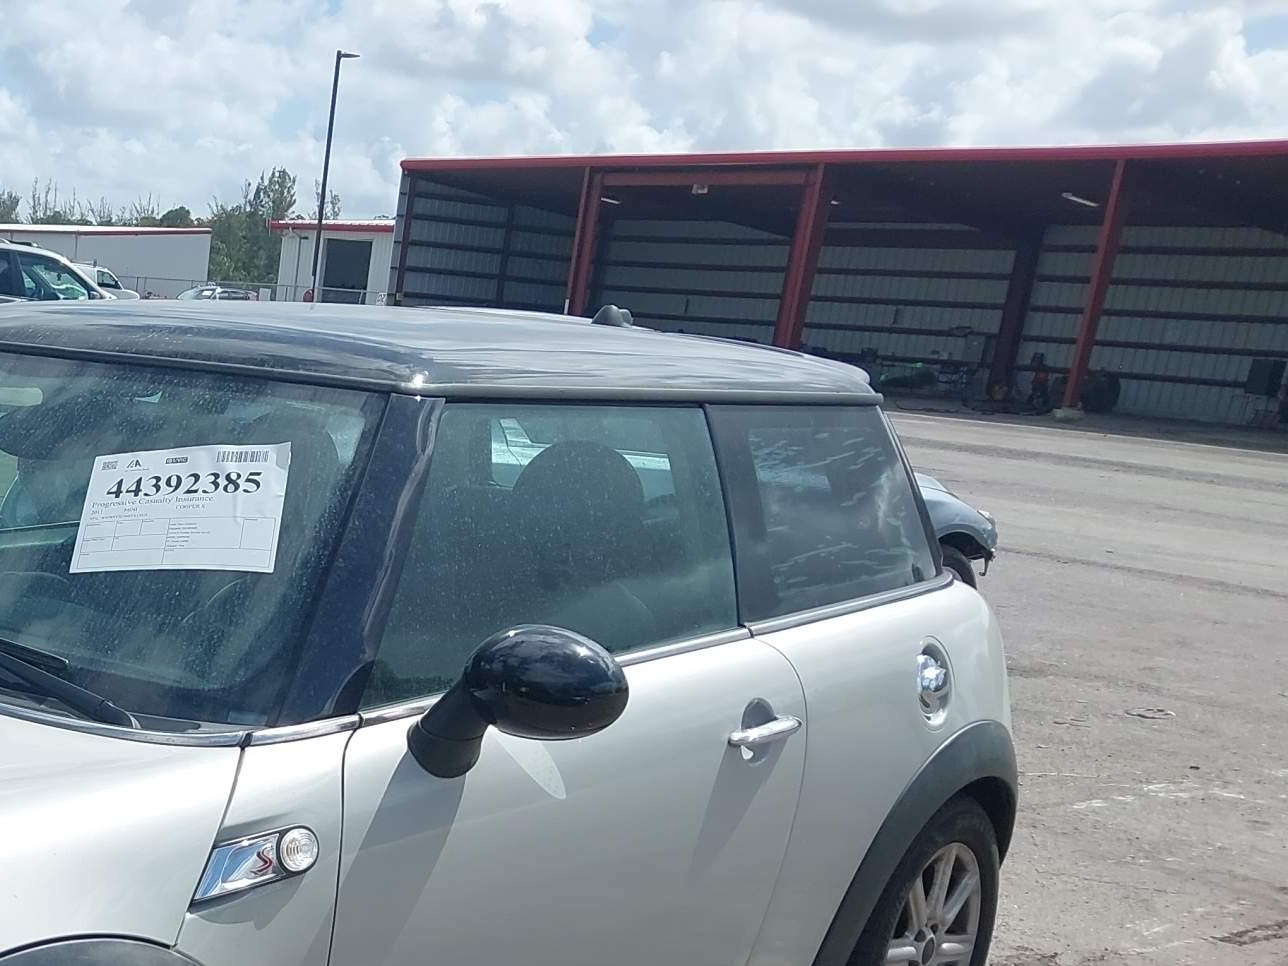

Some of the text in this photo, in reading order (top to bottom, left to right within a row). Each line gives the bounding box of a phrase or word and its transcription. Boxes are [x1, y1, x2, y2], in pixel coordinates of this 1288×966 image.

[106, 471, 263, 498] 44392385
[138, 496, 173, 505] Casualty
[175, 495, 214, 503] Insurance
